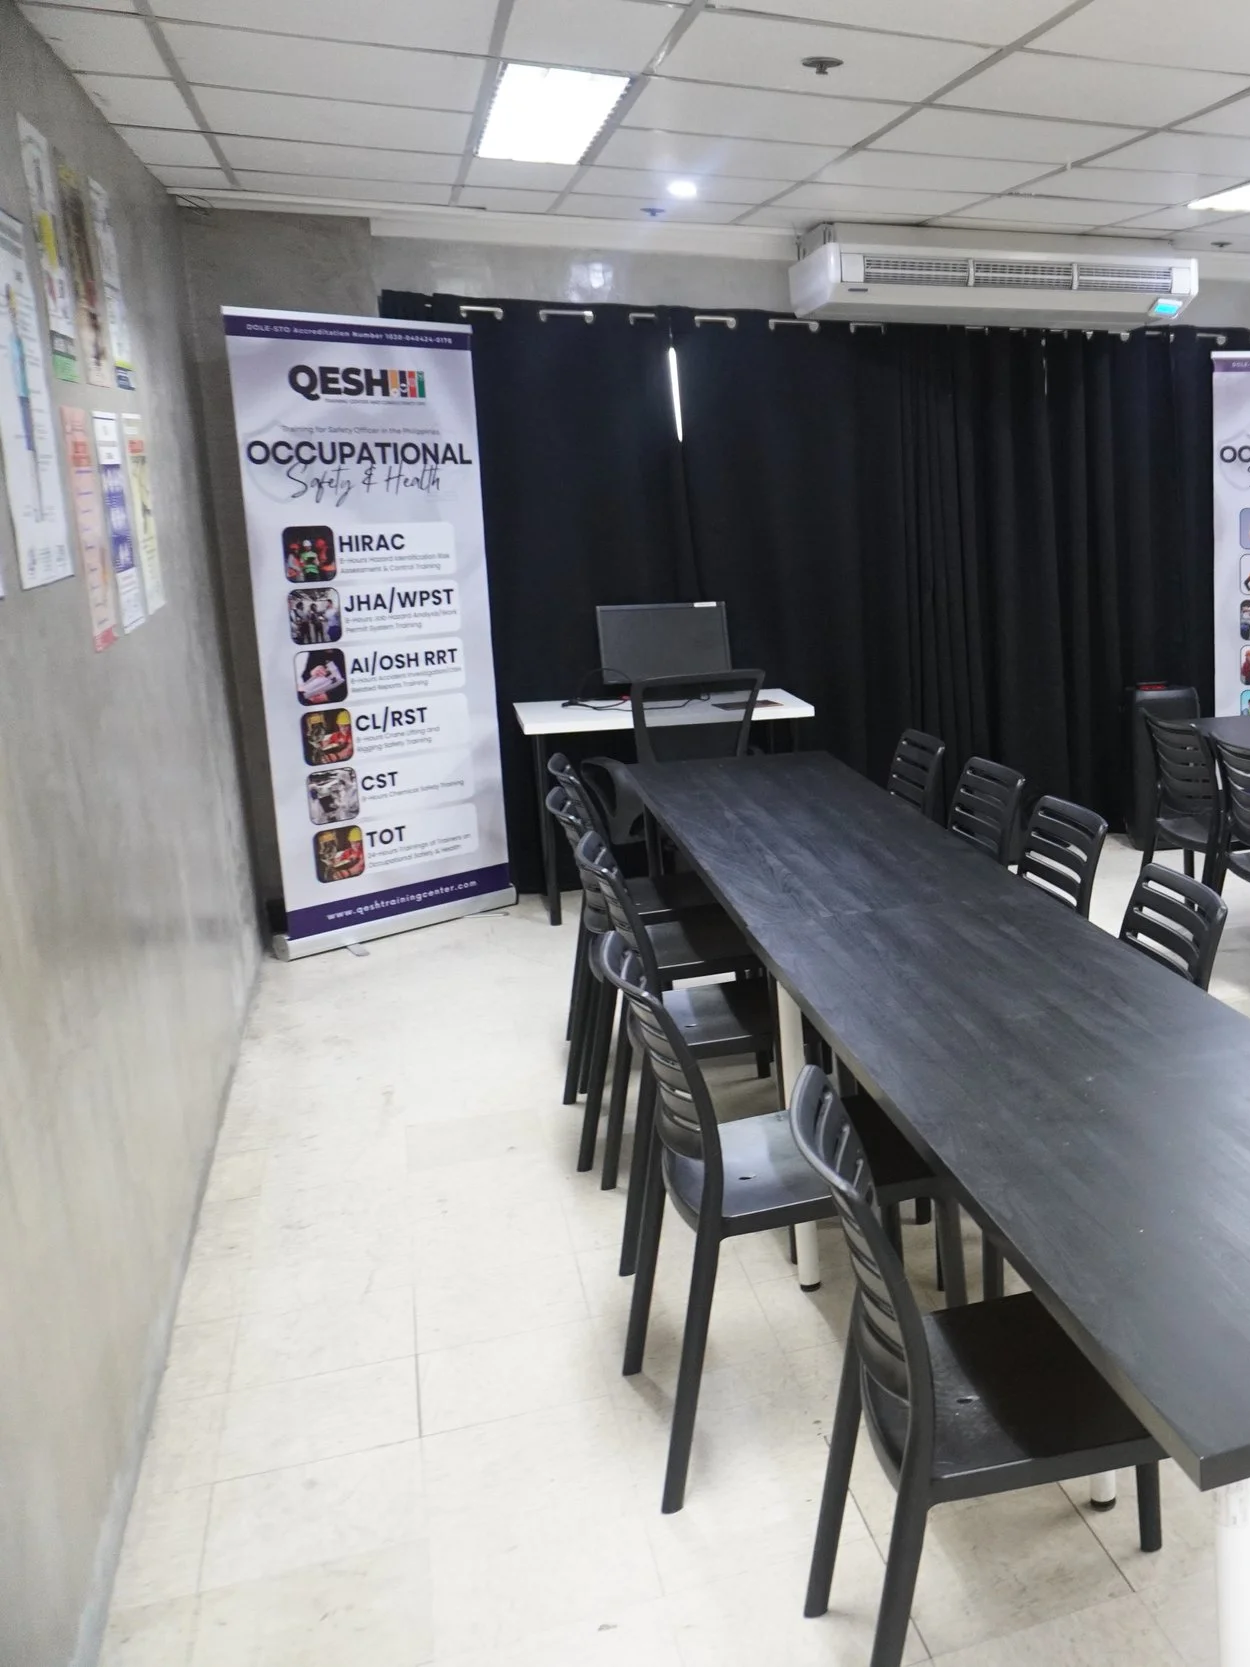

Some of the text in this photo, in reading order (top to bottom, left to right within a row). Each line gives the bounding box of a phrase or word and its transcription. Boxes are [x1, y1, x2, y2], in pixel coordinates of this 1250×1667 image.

[288, 364, 390, 401] QESH
[327, 427, 353, 436] Safety
[354, 427, 379, 435] Officer
[246, 440, 472, 466] OCCUPATIONAL
[286, 462, 355, 507] Safety
[384, 463, 440, 495] Health
[338, 533, 406, 553] HIRAC
[344, 587, 454, 613] JHA/WPST
[350, 648, 458, 676] AI/OSH RRT
[355, 706, 428, 733] CL/RST
[361, 771, 399, 791] CST
[366, 826, 406, 847] TOT
[326, 880, 478, 920] www.qeshtrainingcenter.com
